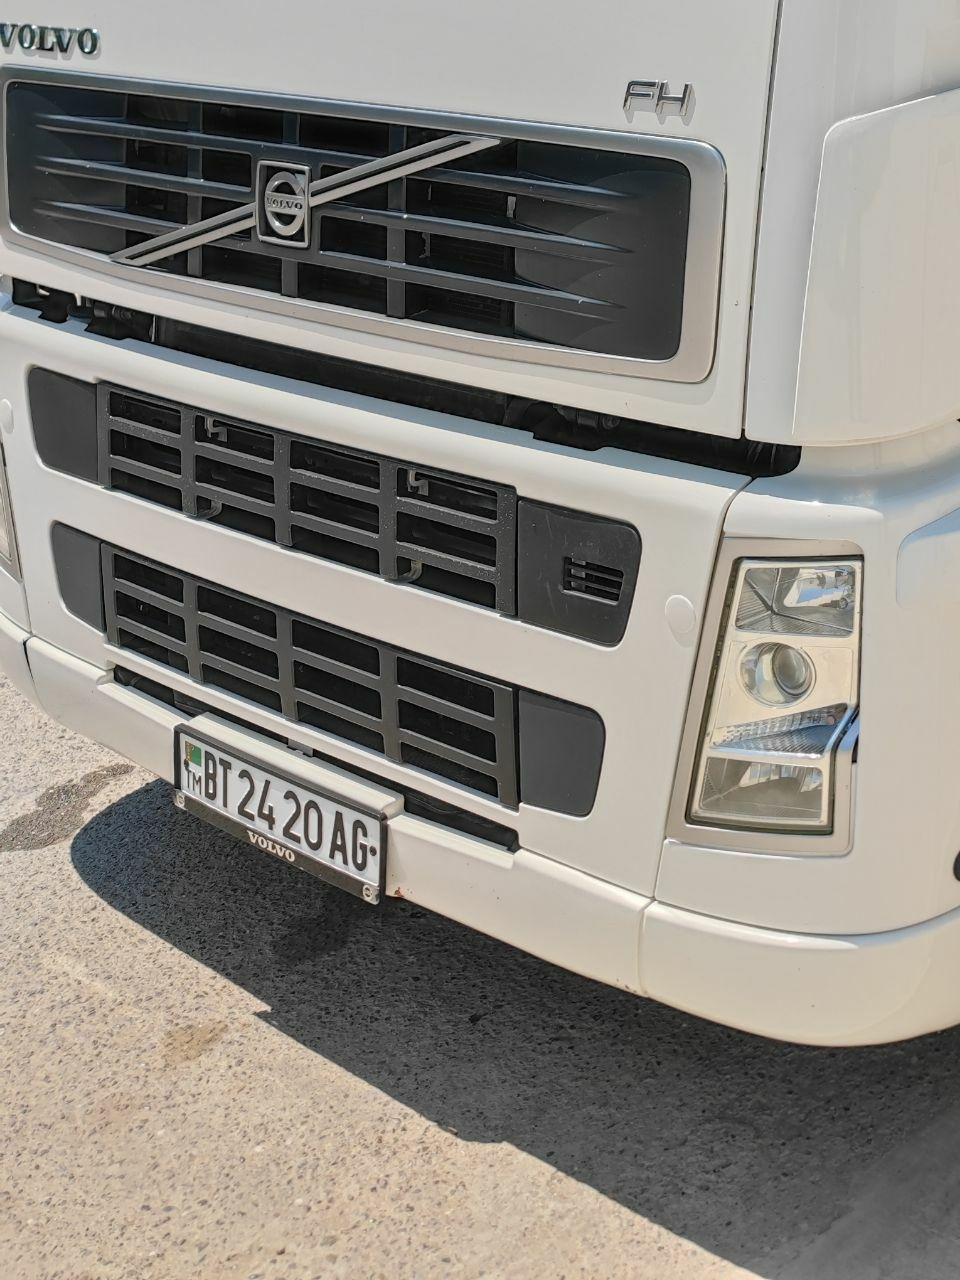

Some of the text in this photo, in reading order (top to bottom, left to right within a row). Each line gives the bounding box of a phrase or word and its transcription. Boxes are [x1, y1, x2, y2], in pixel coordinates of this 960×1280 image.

[0, 23, 99, 55] VOLVO
[622, 79, 694, 116] FH
[266, 197, 303, 210] VOLVO
[186, 769, 202, 796] TM
[247, 829, 296, 863] VOLVO
